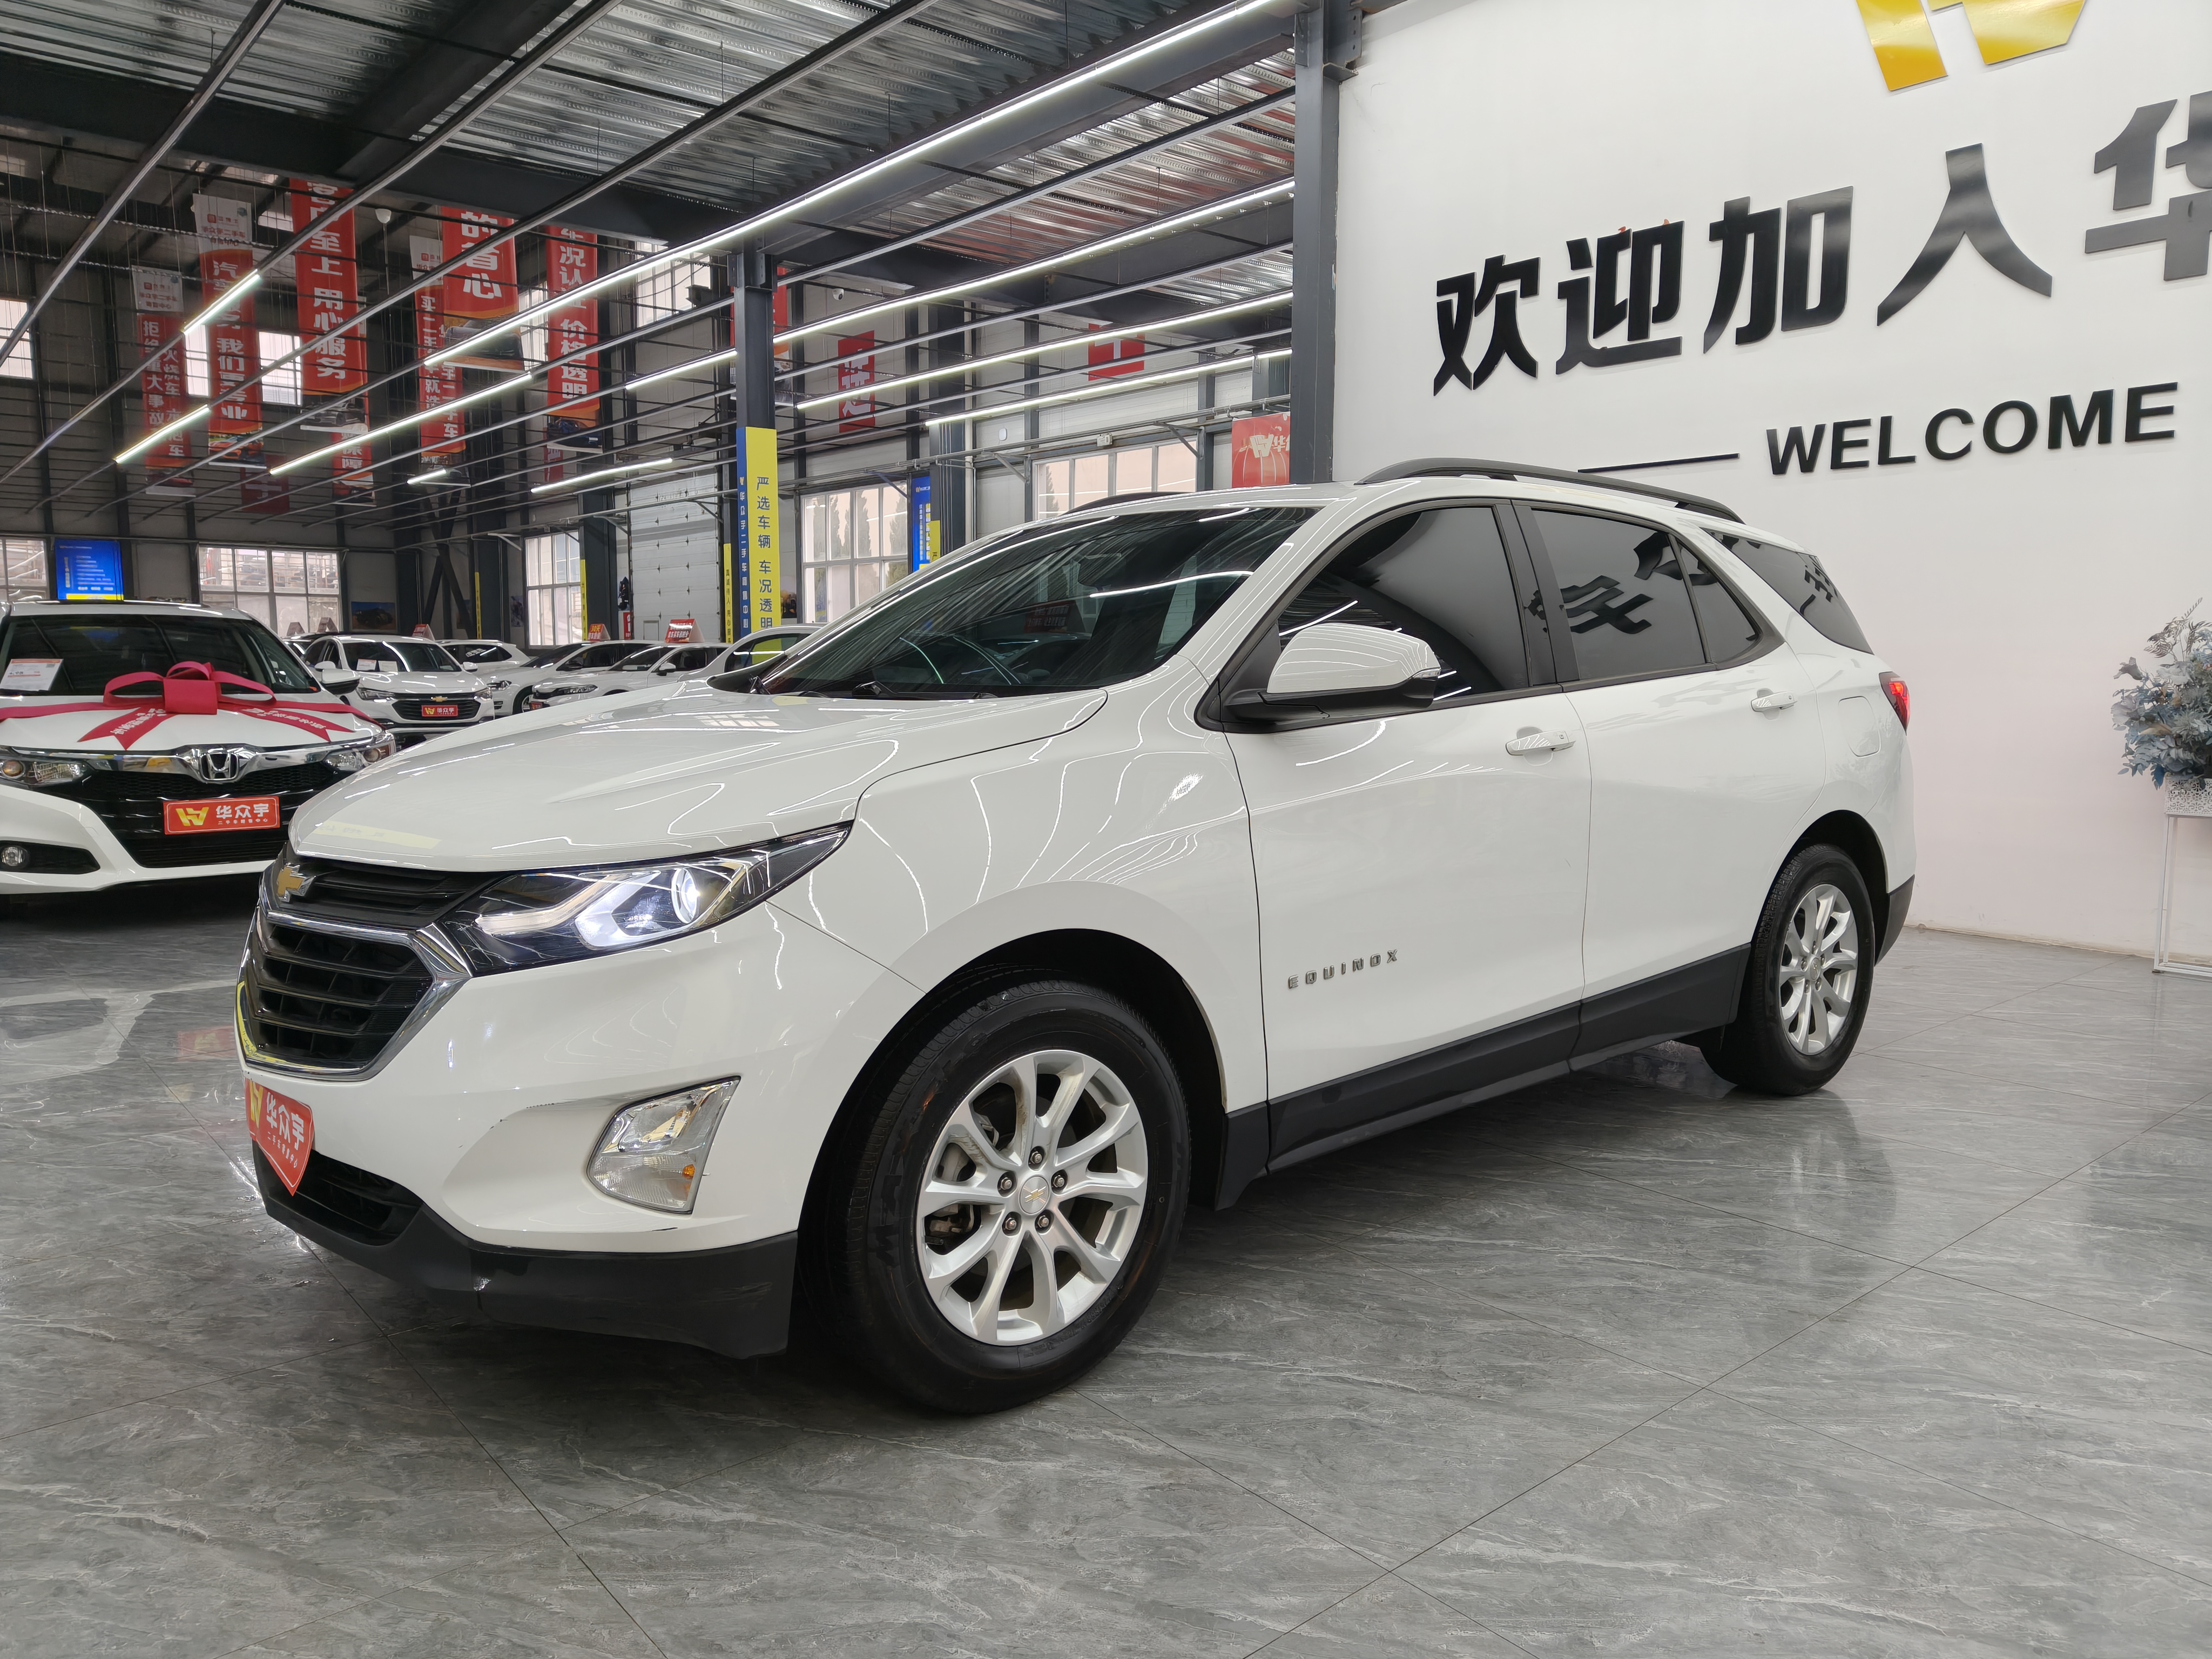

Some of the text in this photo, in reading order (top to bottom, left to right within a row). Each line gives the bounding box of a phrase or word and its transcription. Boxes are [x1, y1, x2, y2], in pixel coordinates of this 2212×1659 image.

[313, 287, 346, 379] 用心服务
[560, 319, 588, 399] 价格透明
[1766, 382, 2178, 476] WELCOME
[756, 476, 773, 628] 严选车辆 车况透明
[215, 804, 269, 819] 华众宇
[1287, 948, 1398, 989] EQUINOX
[266, 1091, 305, 1151] 华众宇
